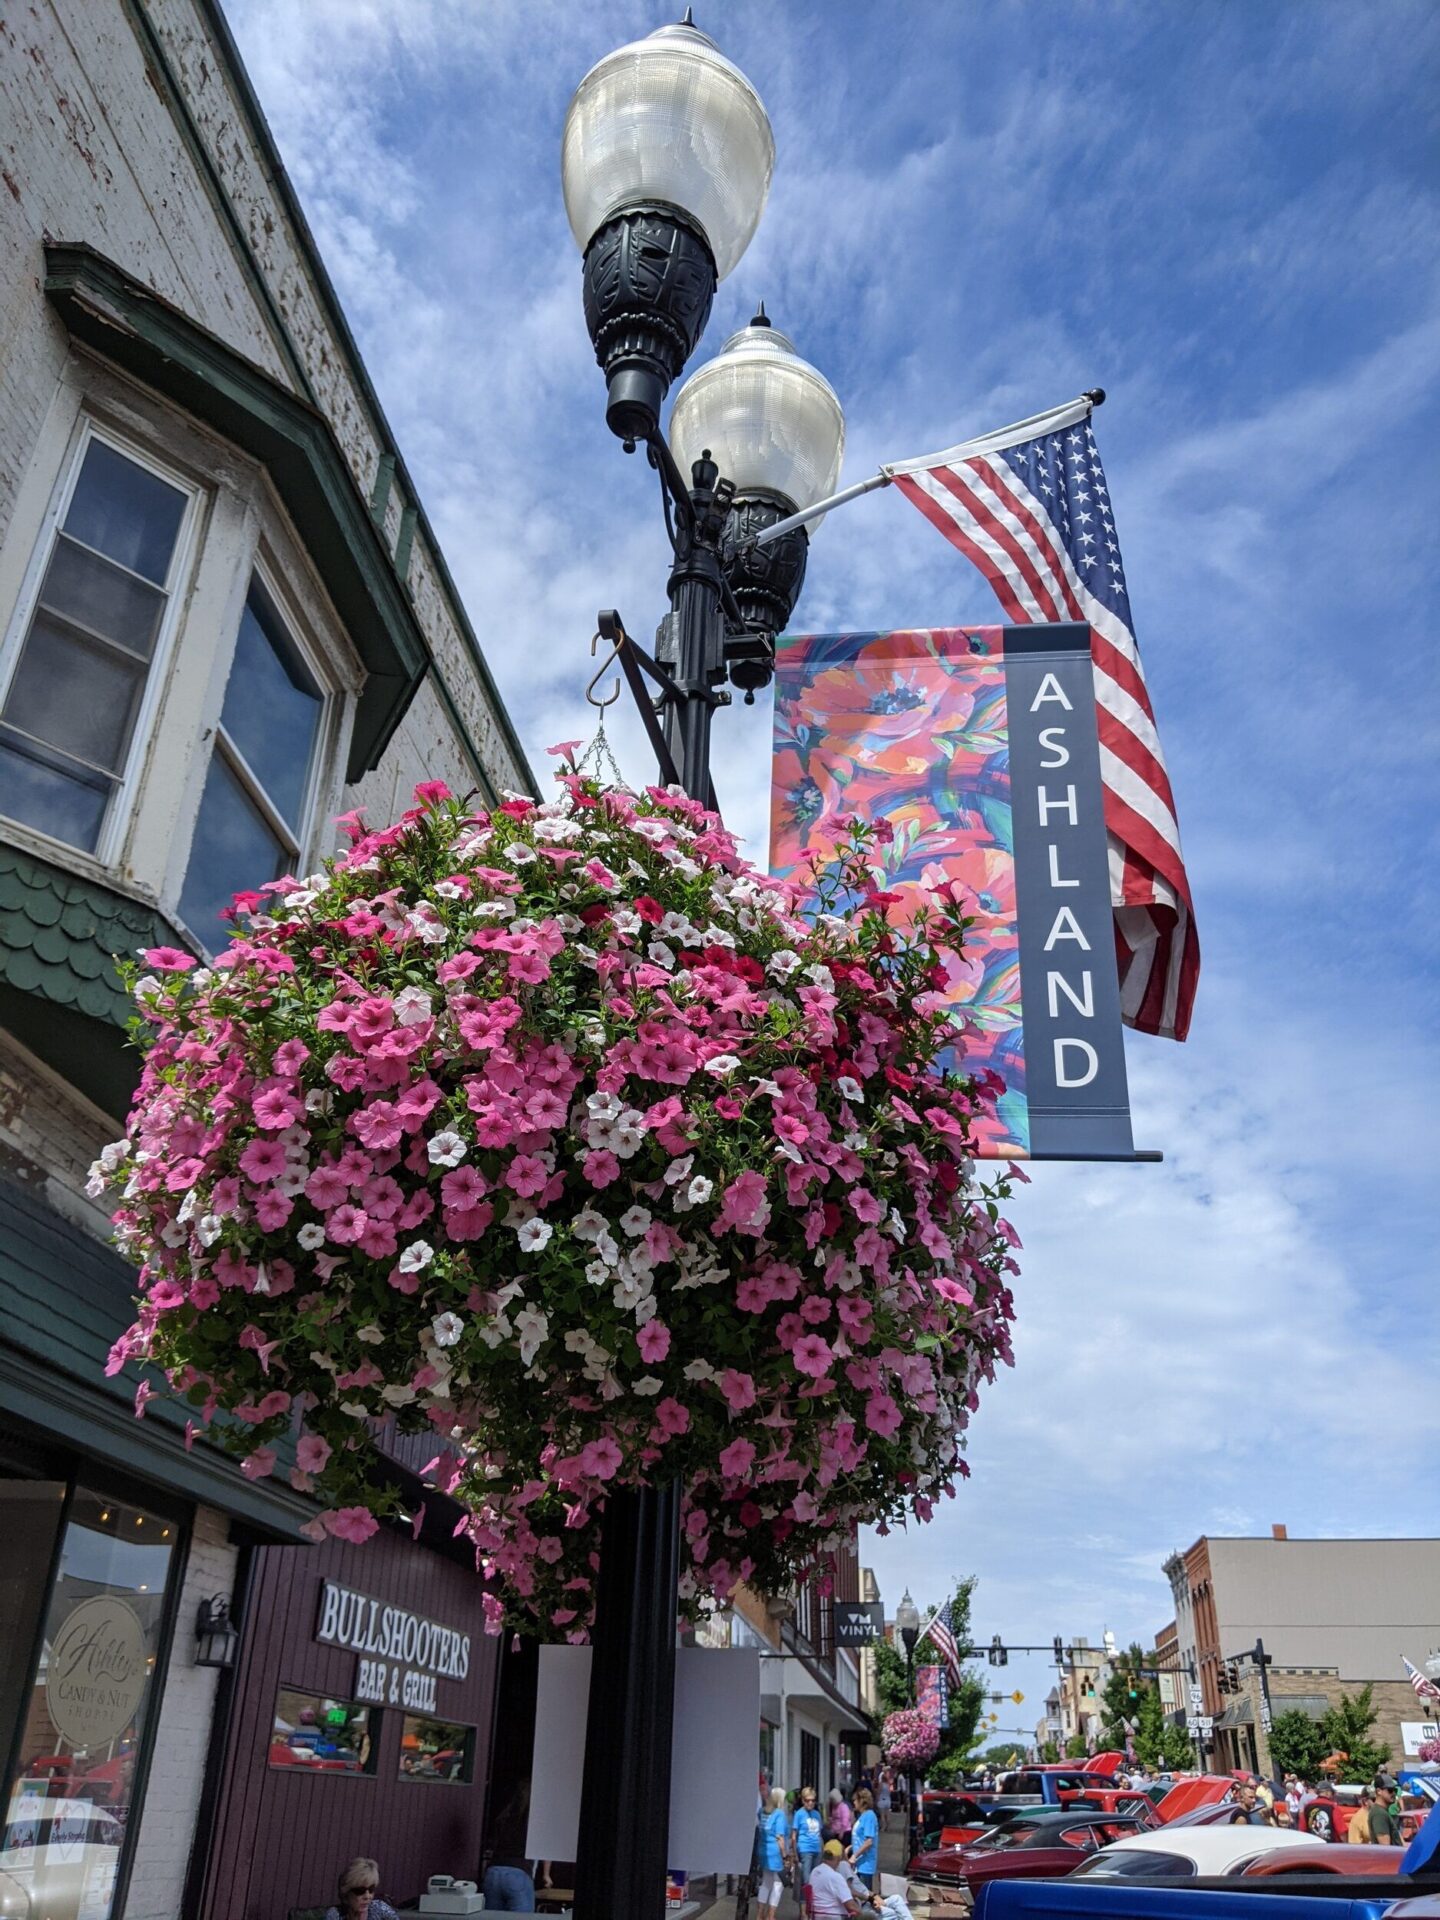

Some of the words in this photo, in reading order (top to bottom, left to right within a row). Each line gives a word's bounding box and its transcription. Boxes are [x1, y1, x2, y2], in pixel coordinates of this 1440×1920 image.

[1029, 672, 1099, 1089] ASHLAND
[319, 1583, 471, 1679] BULLSHOOTERS
[839, 1625, 880, 1636] VINYL
[357, 1659, 387, 1701] BAR
[389, 1666, 399, 1704] &
[402, 1670, 437, 1712] GRILL
[940, 1671, 949, 1722] ASHLAND
